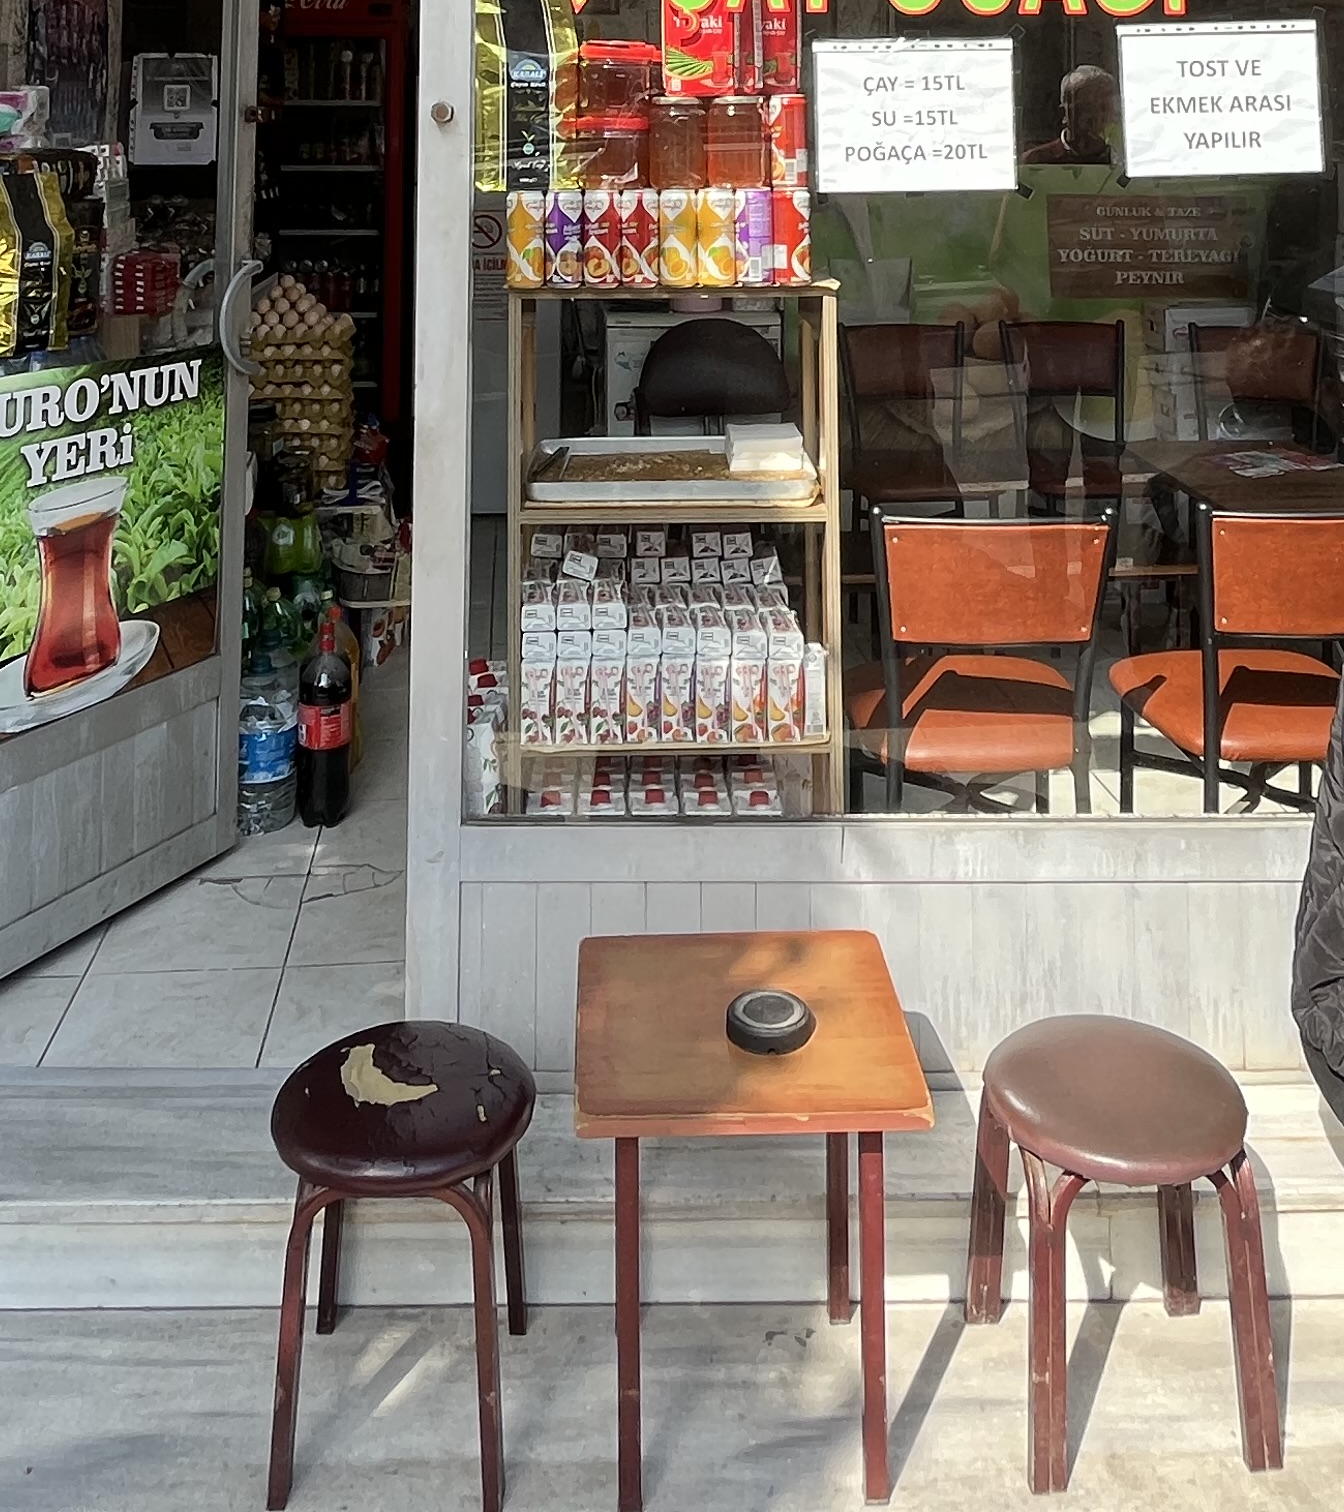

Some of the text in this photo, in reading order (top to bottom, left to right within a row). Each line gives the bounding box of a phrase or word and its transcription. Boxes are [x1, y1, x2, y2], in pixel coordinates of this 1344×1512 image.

[1175, 58, 1262, 79] TOST VE
[863, 75, 899, 96] ÇAY
[920, 74, 966, 93] 15TL
[1150, 94, 1293, 115] EKMEK ARASI
[871, 109, 959, 128] SU =15TL
[1182, 131, 1262, 151] YAPILIR
[844, 141, 988, 166] POĞAÇA =20TL
[1167, 206, 1202, 218] TAZE
[1079, 223, 1115, 241] SÜT
[1129, 227, 1219, 241] YUMURTA
[1056, 245, 1134, 264] YOĞURT
